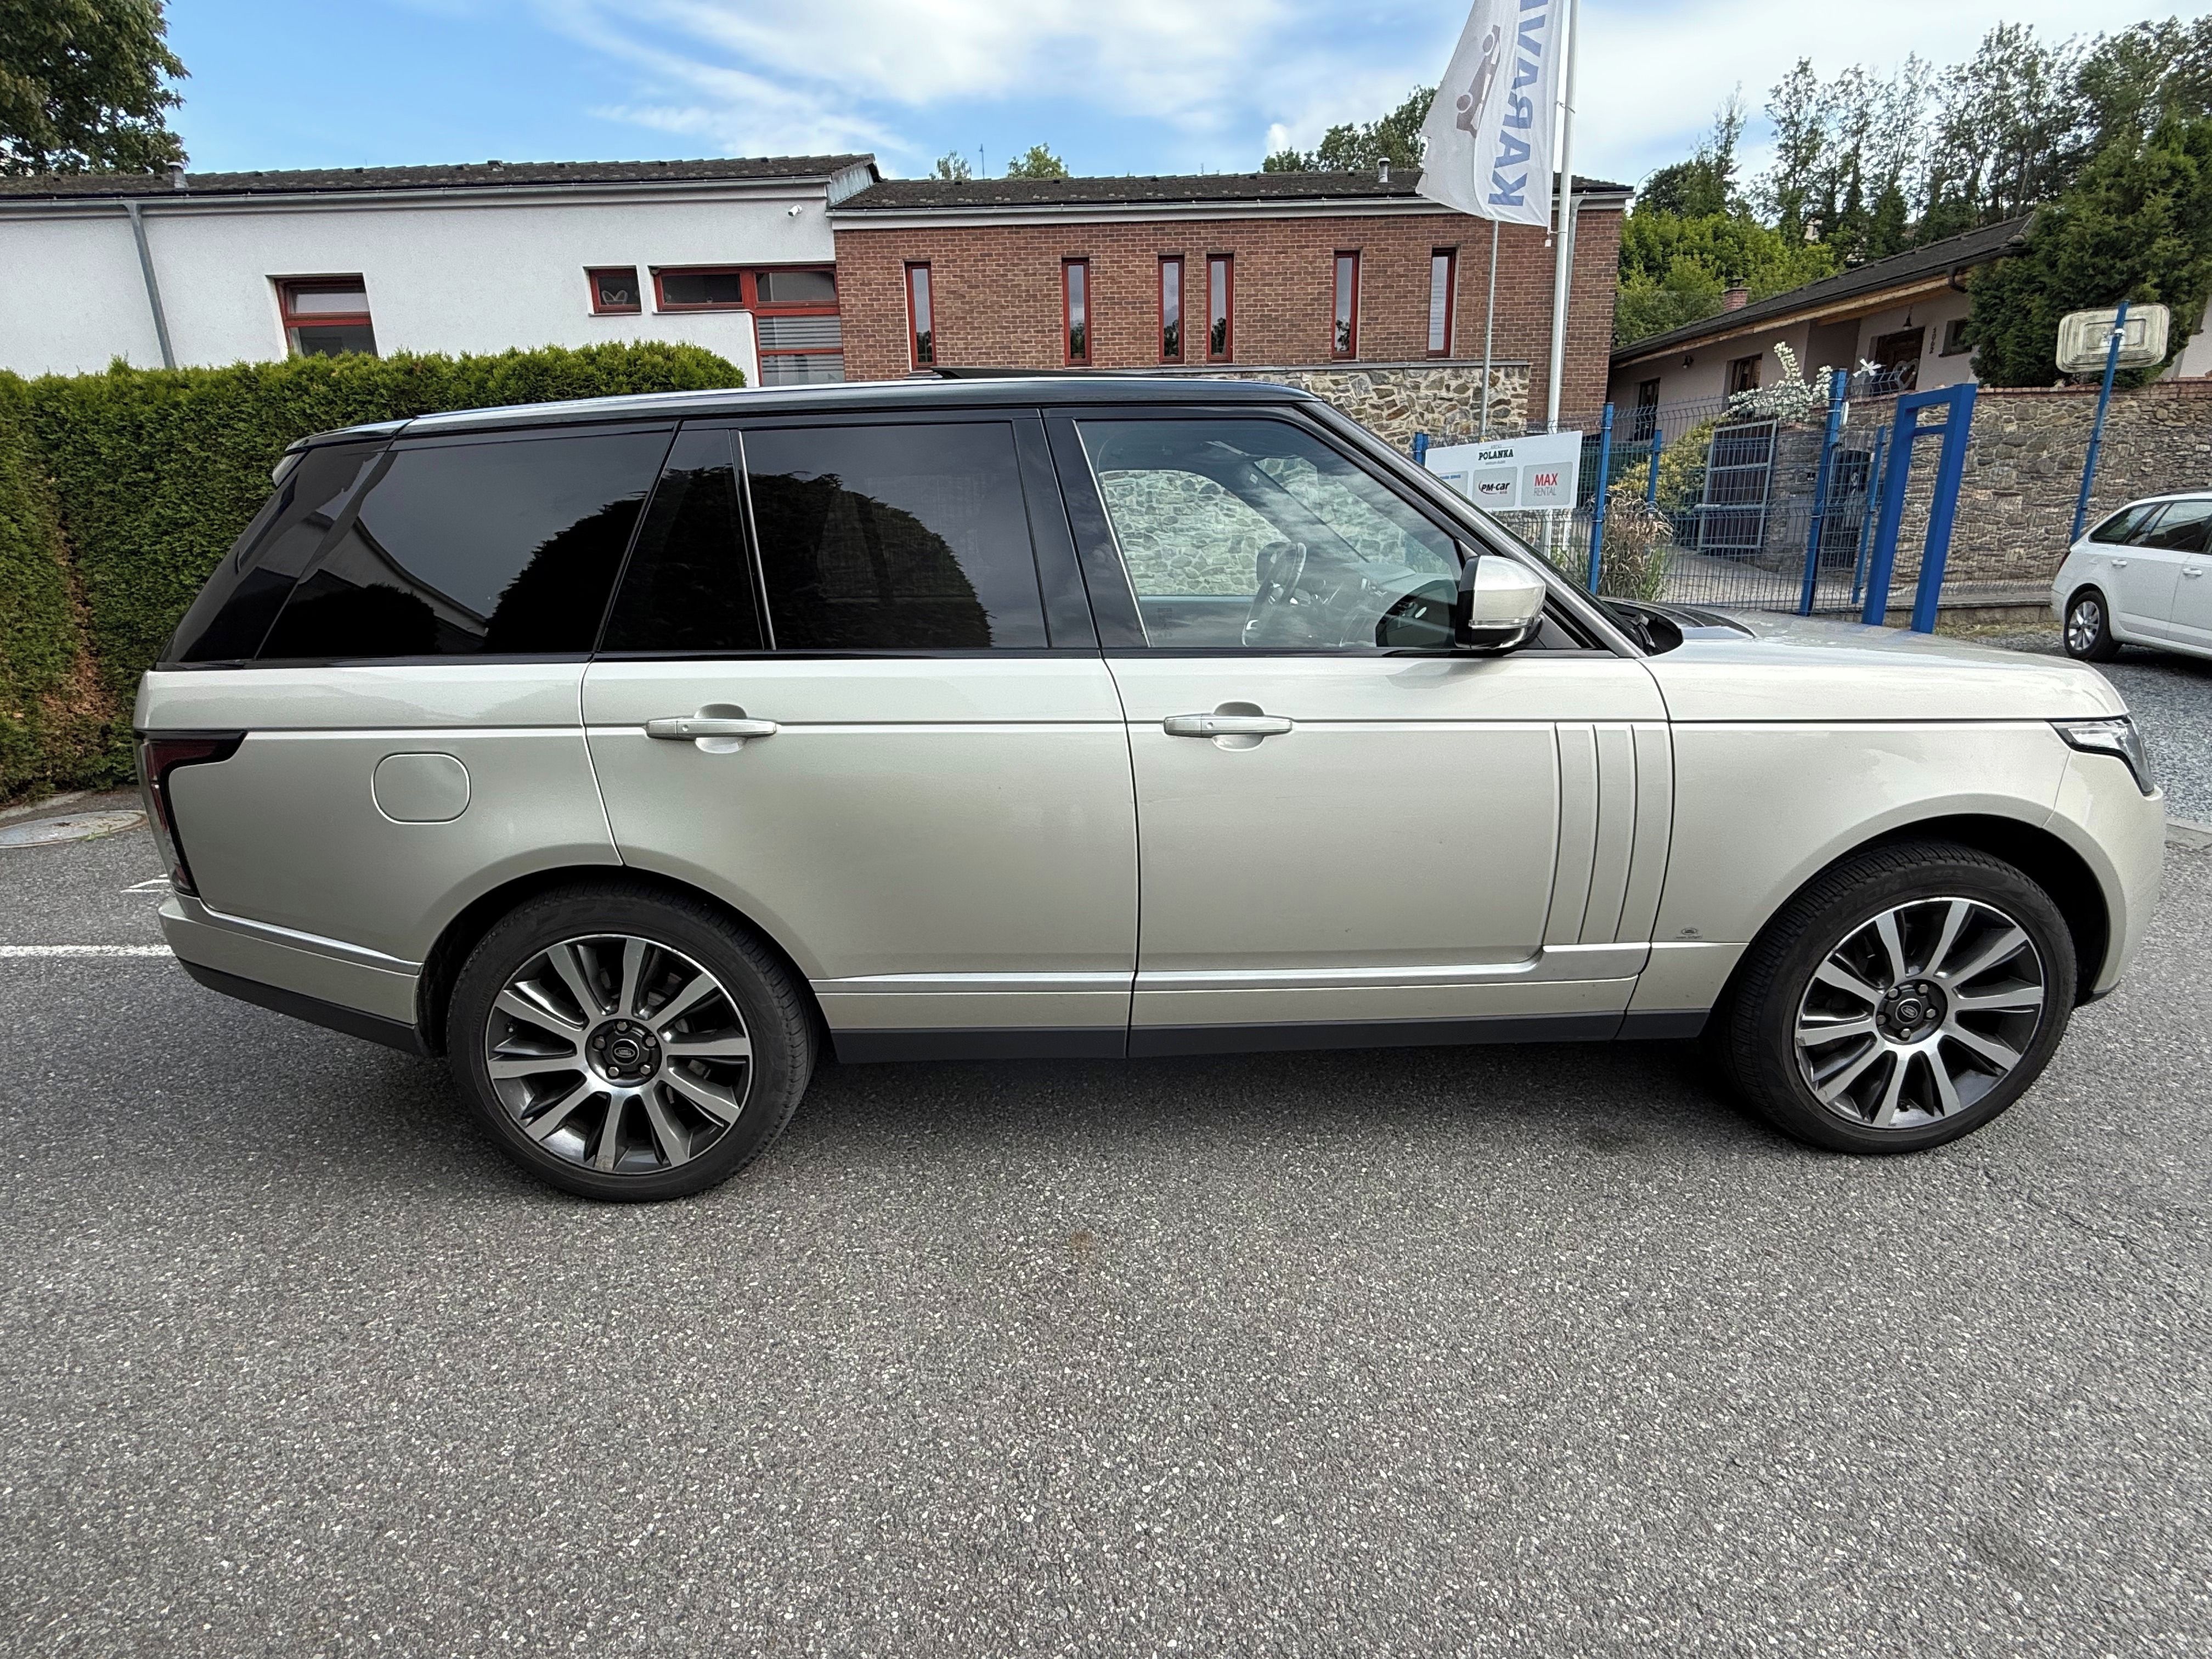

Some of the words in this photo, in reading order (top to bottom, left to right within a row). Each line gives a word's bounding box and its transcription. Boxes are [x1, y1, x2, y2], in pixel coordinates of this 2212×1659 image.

[1478, 449, 1514, 460] POLANKA
[1534, 472, 1558, 487] MAX
[1481, 482, 1510, 492] PM-car
[1533, 487, 1557, 496] RENTAL
